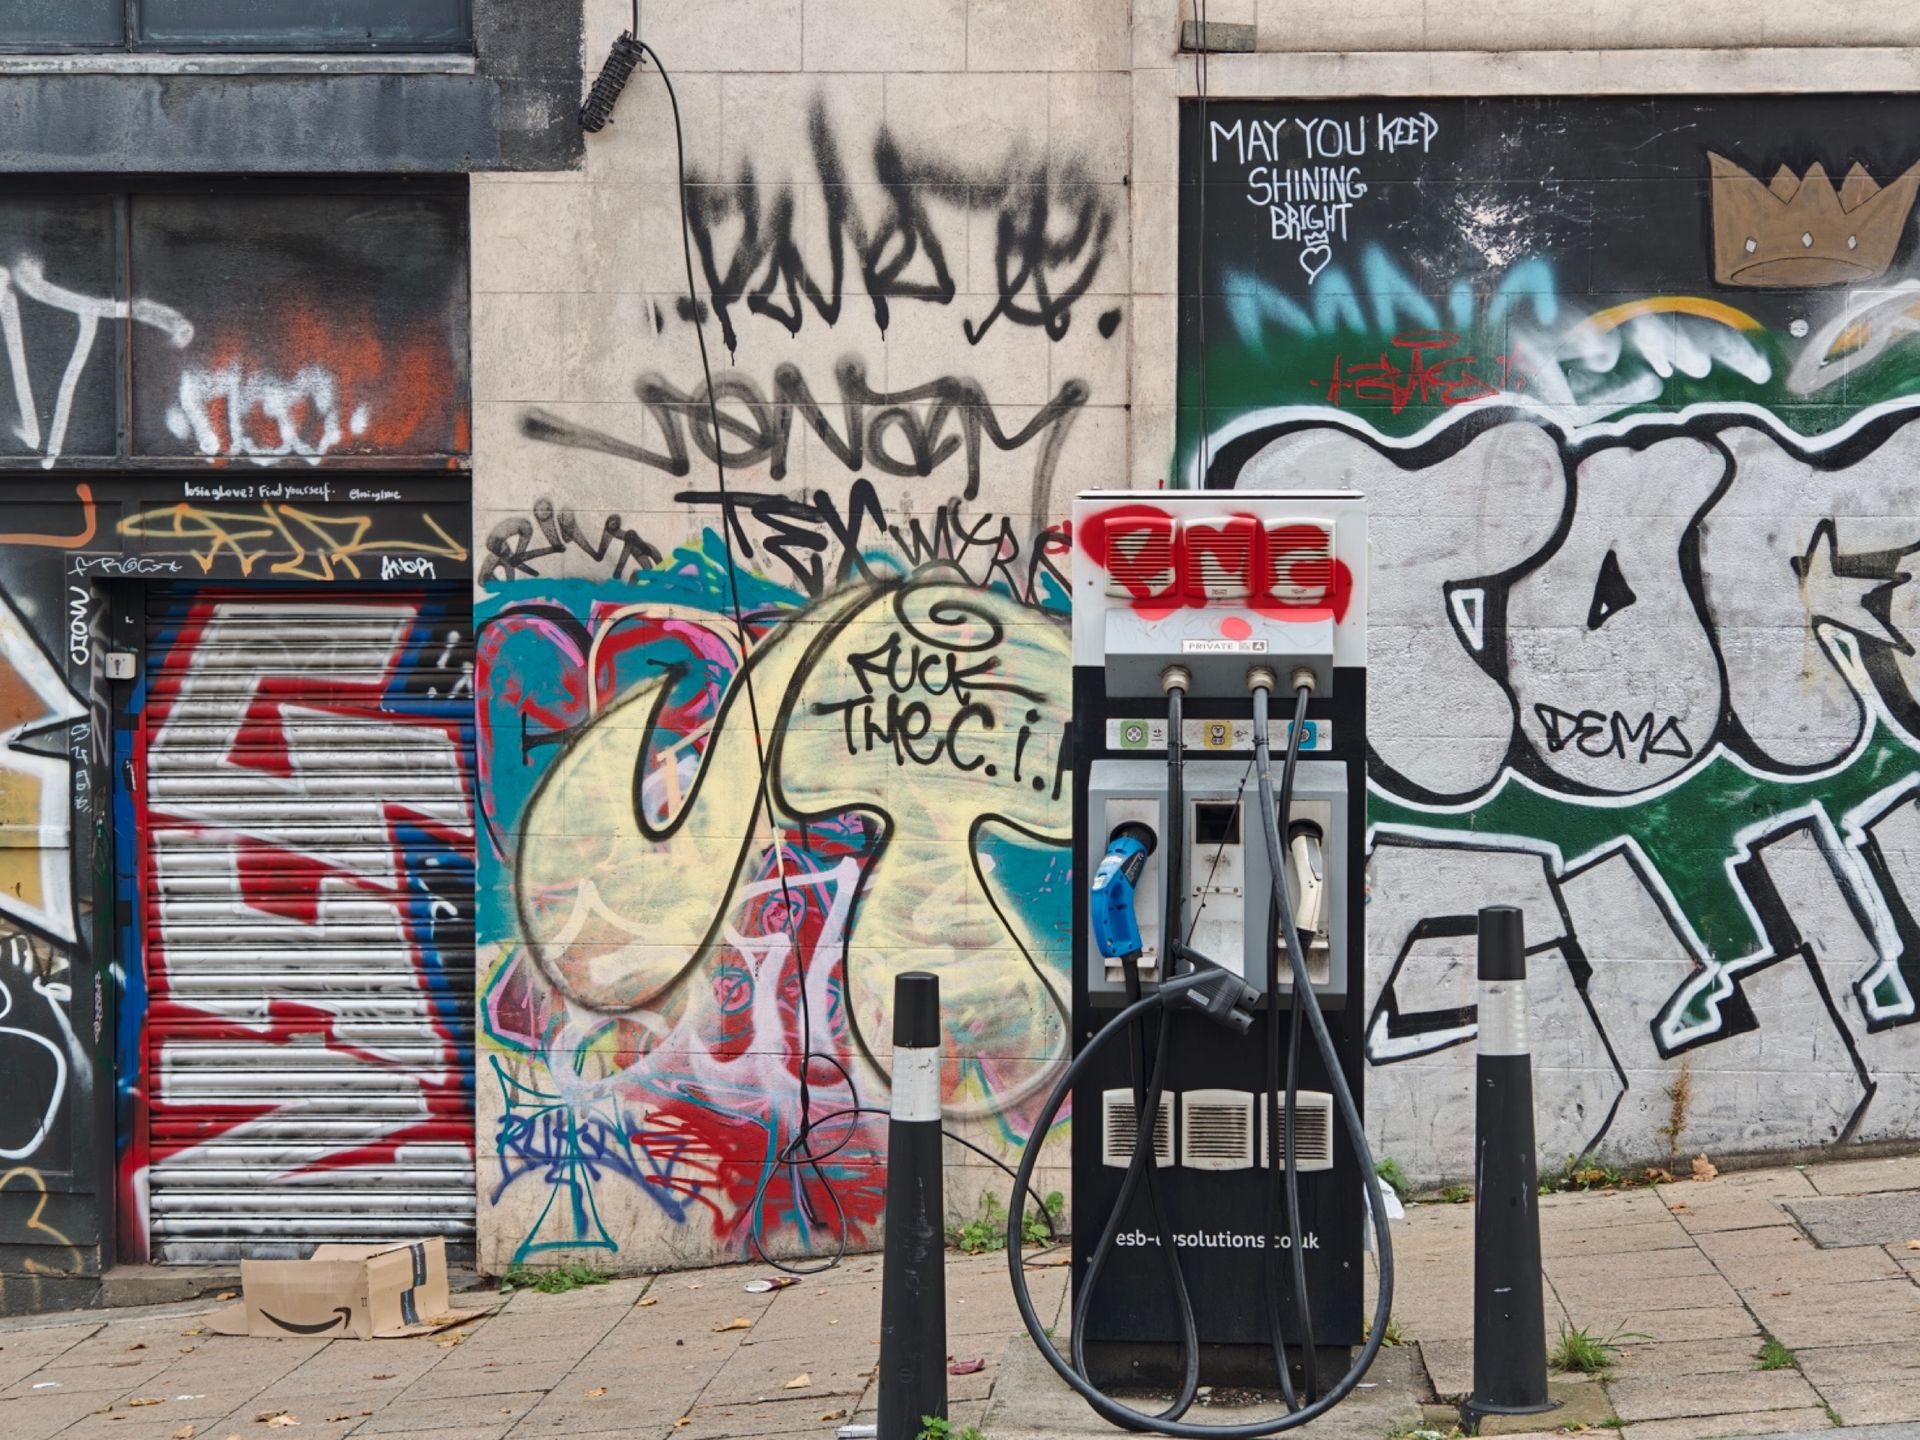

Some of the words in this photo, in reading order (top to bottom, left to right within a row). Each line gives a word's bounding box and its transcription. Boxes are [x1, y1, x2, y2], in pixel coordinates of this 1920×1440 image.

[1210, 118, 1286, 164] MAY
[1295, 116, 1365, 159] YOU
[1378, 112, 1439, 153] KEEP
[1247, 165, 1367, 205] SHINING
[1270, 203, 1353, 241] BRIGHT
[1189, 642, 1233, 650] PRIVATE
[847, 631, 1047, 705] FUCK
